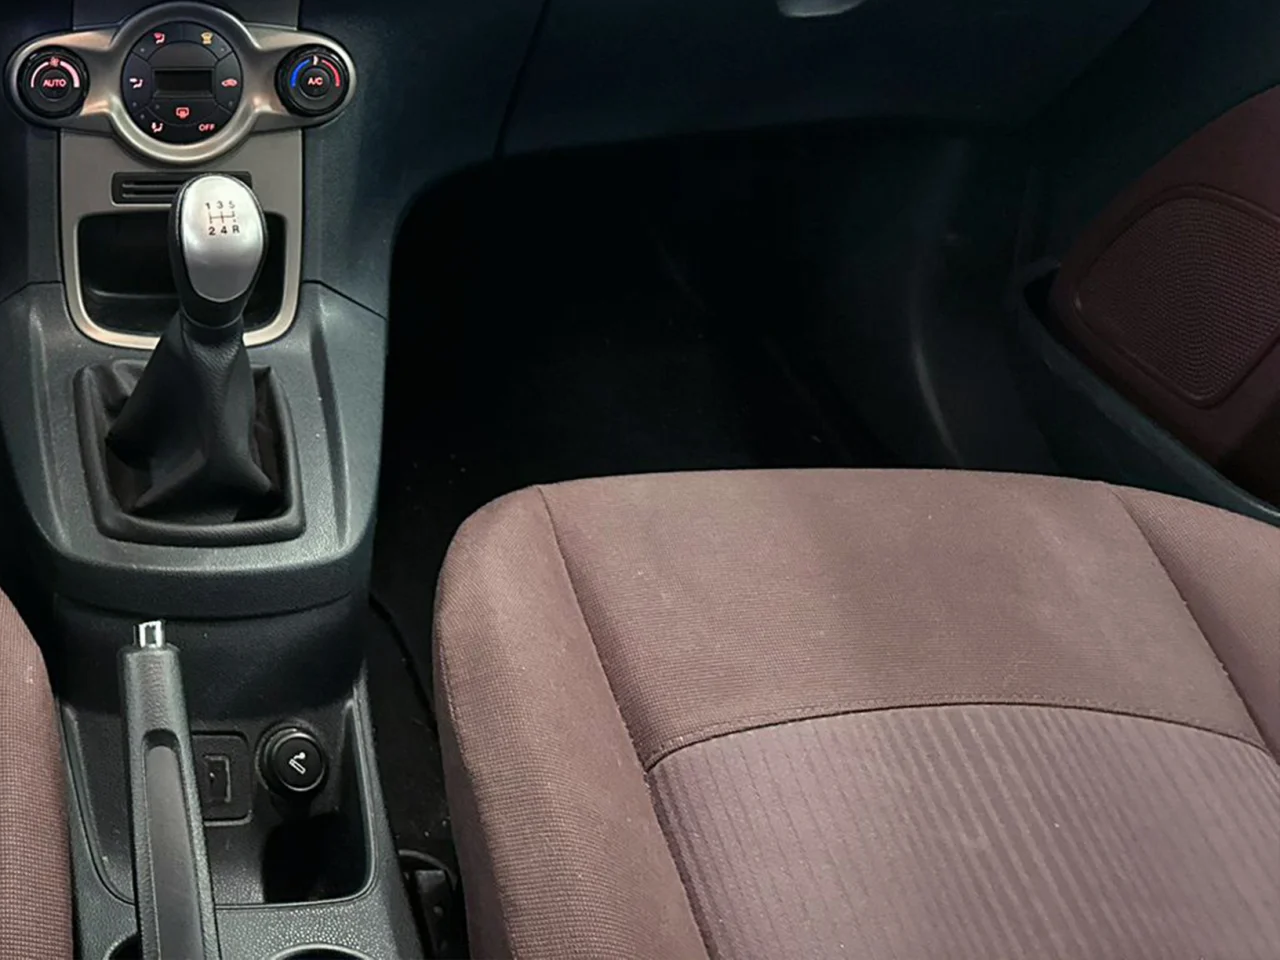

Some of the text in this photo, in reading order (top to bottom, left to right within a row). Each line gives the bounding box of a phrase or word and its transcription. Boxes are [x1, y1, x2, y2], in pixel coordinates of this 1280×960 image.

[43, 78, 67, 88] AUTO
[307, 76, 324, 86] A/C
[198, 122, 216, 132] OFF
[208, 225, 240, 236] 2 4 R
